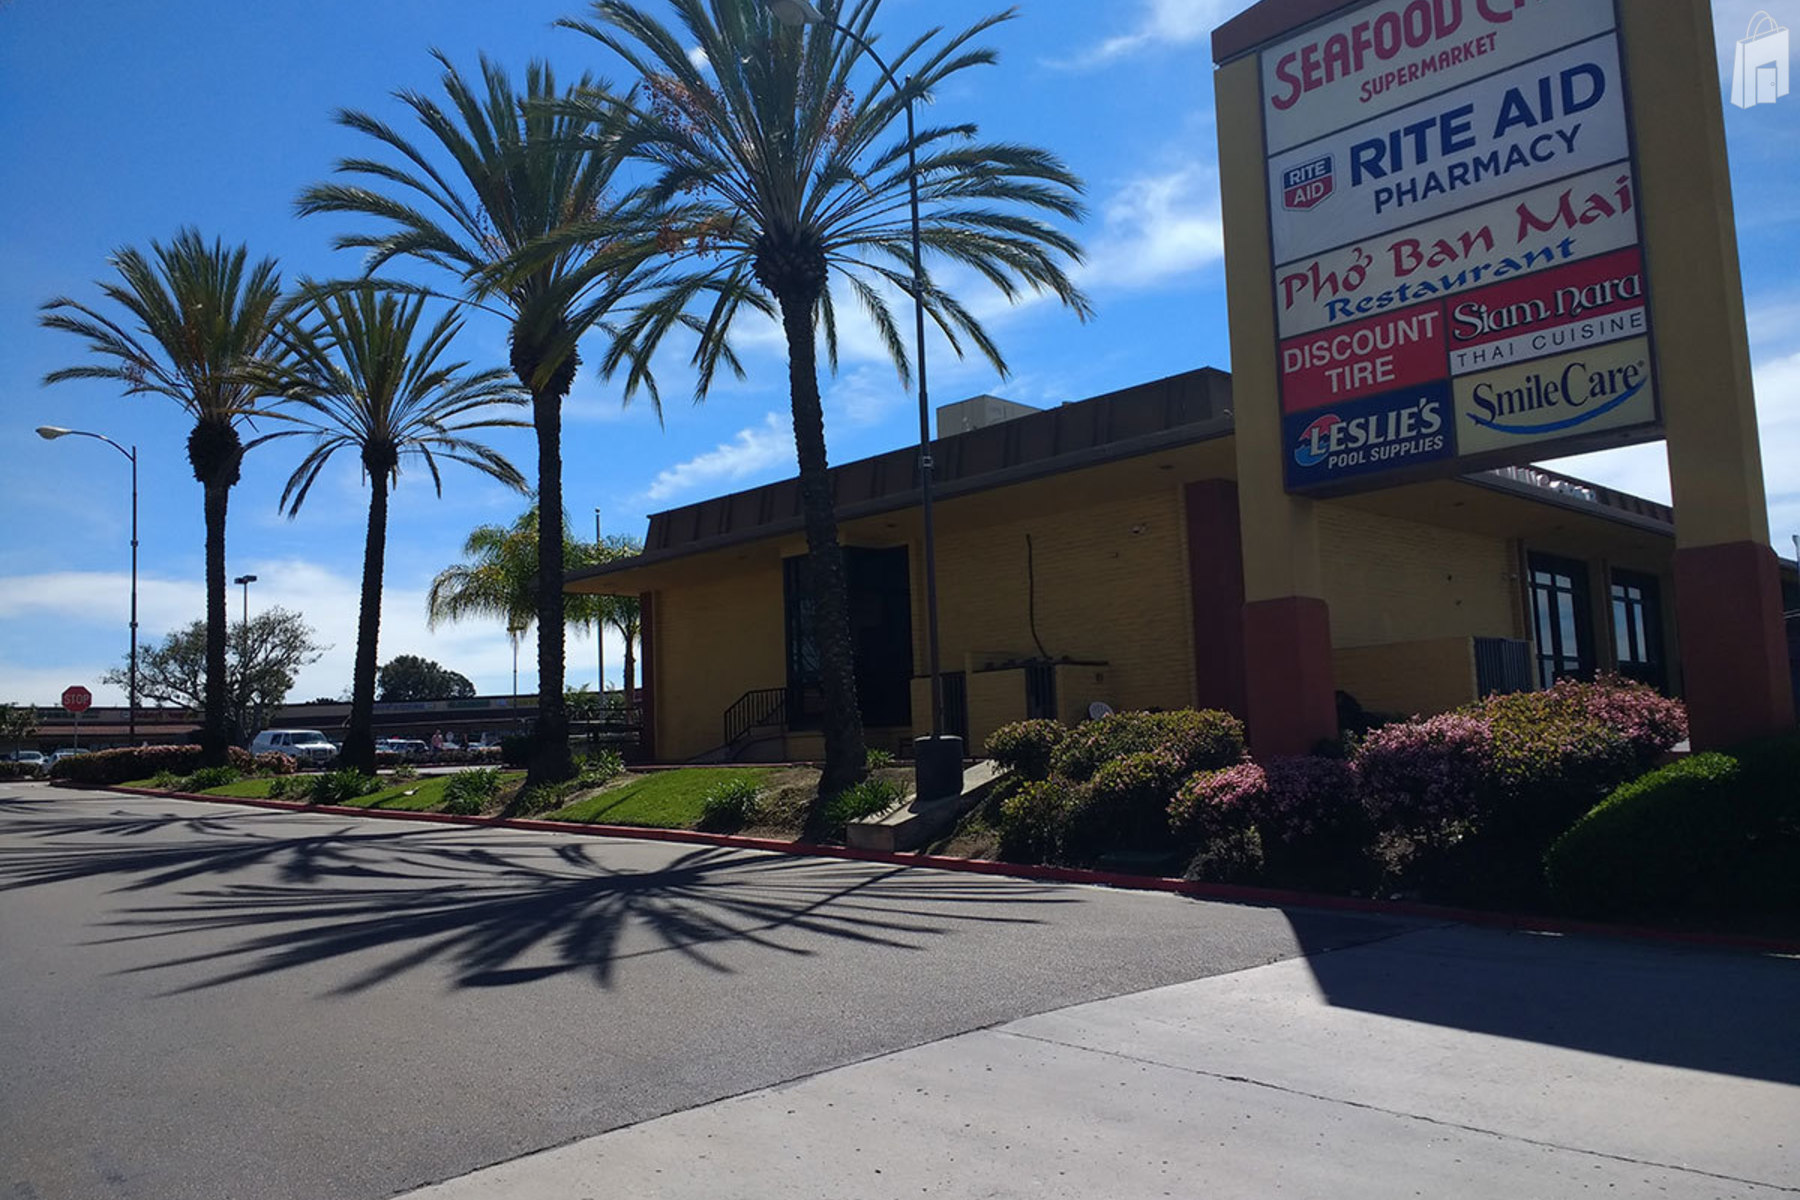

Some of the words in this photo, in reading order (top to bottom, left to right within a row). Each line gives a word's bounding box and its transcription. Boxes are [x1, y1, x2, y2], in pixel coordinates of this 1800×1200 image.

[1271, 0, 1463, 110] SEAFOOD
[1359, 32, 1498, 103] SUPERMARKET
[1350, 103, 1476, 187] RITE
[1493, 62, 1606, 139] AID
[1290, 160, 1326, 185] RITE
[1294, 182, 1324, 206] AID
[1374, 123, 1582, 214] PHARMACY
[1387, 224, 1495, 279] Ban
[1515, 175, 1633, 244] Mai
[1323, 236, 1577, 322] Restaurant
[1283, 311, 1439, 373] DISCOUNT
[1452, 299, 1550, 341] Siam
[1457, 342, 1514, 367] THAI
[1531, 311, 1643, 351] CUISINE
[1325, 355, 1396, 393] TIRE
[1310, 397, 1443, 456] LESLIE'S
[1328, 452, 1367, 469] POOL
[1370, 435, 1444, 462] SUPPLIES
[64, 694, 90, 705] STOP
